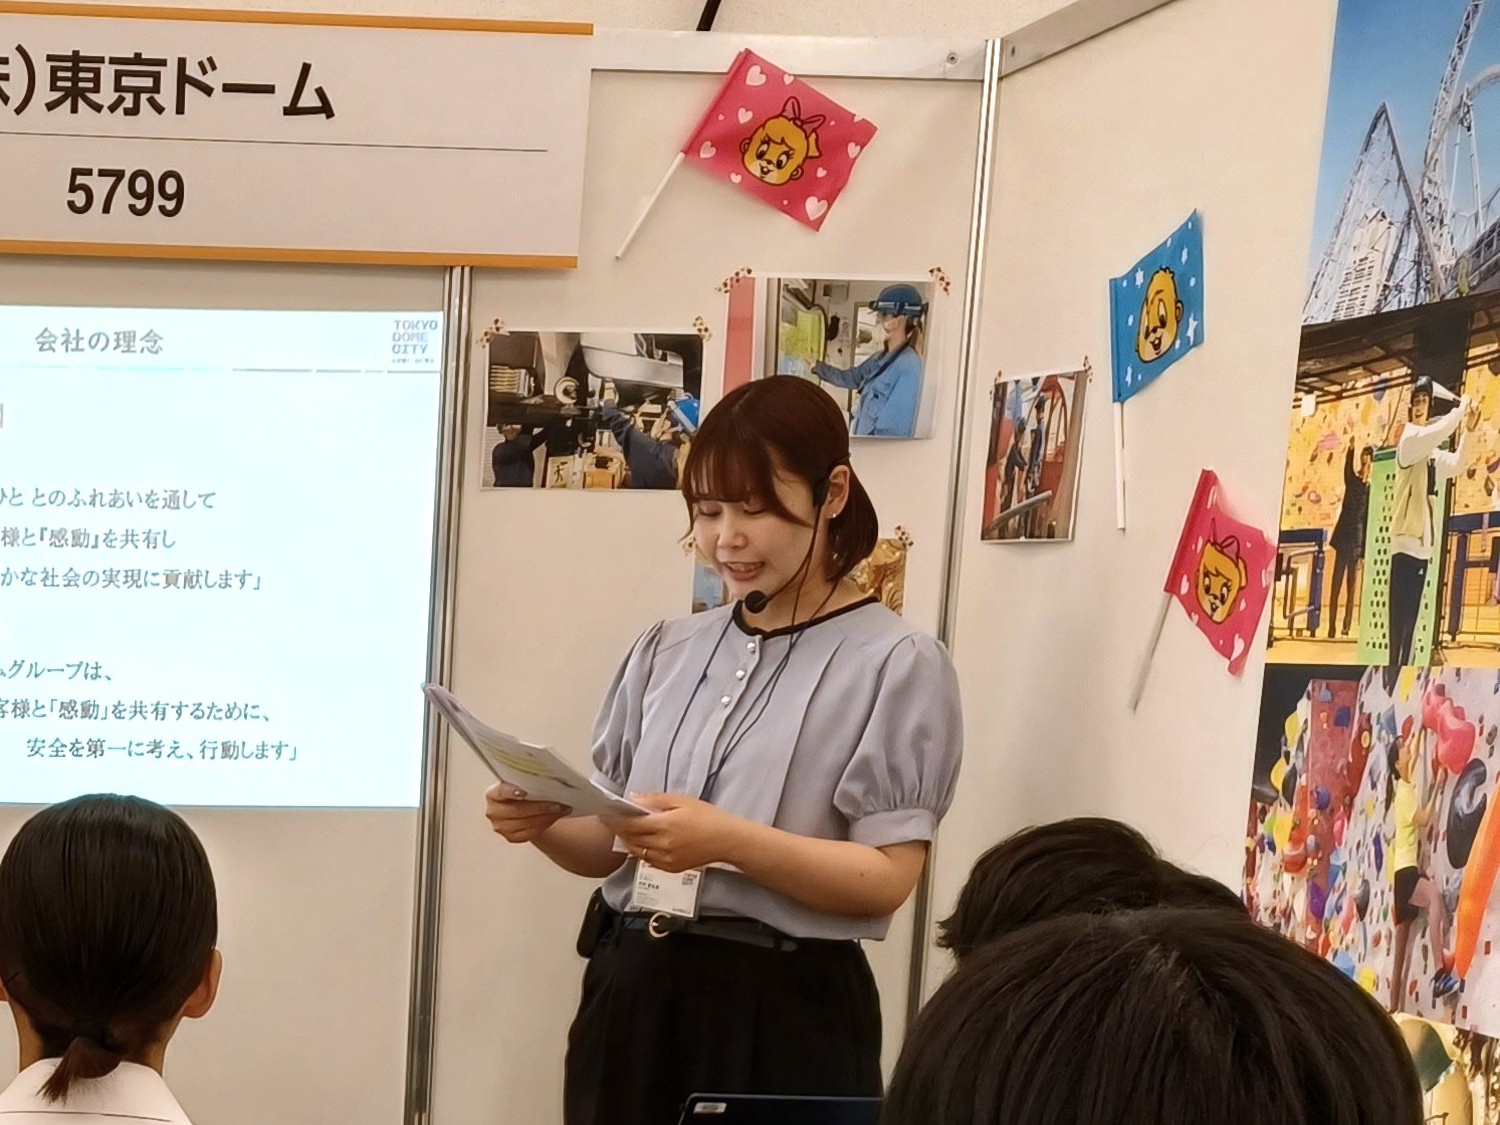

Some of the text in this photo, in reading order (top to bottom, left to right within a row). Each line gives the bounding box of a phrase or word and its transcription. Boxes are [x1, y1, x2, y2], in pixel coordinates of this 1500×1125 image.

[65, 166, 185, 218] 5799
[393, 319, 438, 331] TOKYO
[34, 326, 164, 355] 会社の理念
[25, 736, 298, 762] 安全を第一に考え、行動します」
